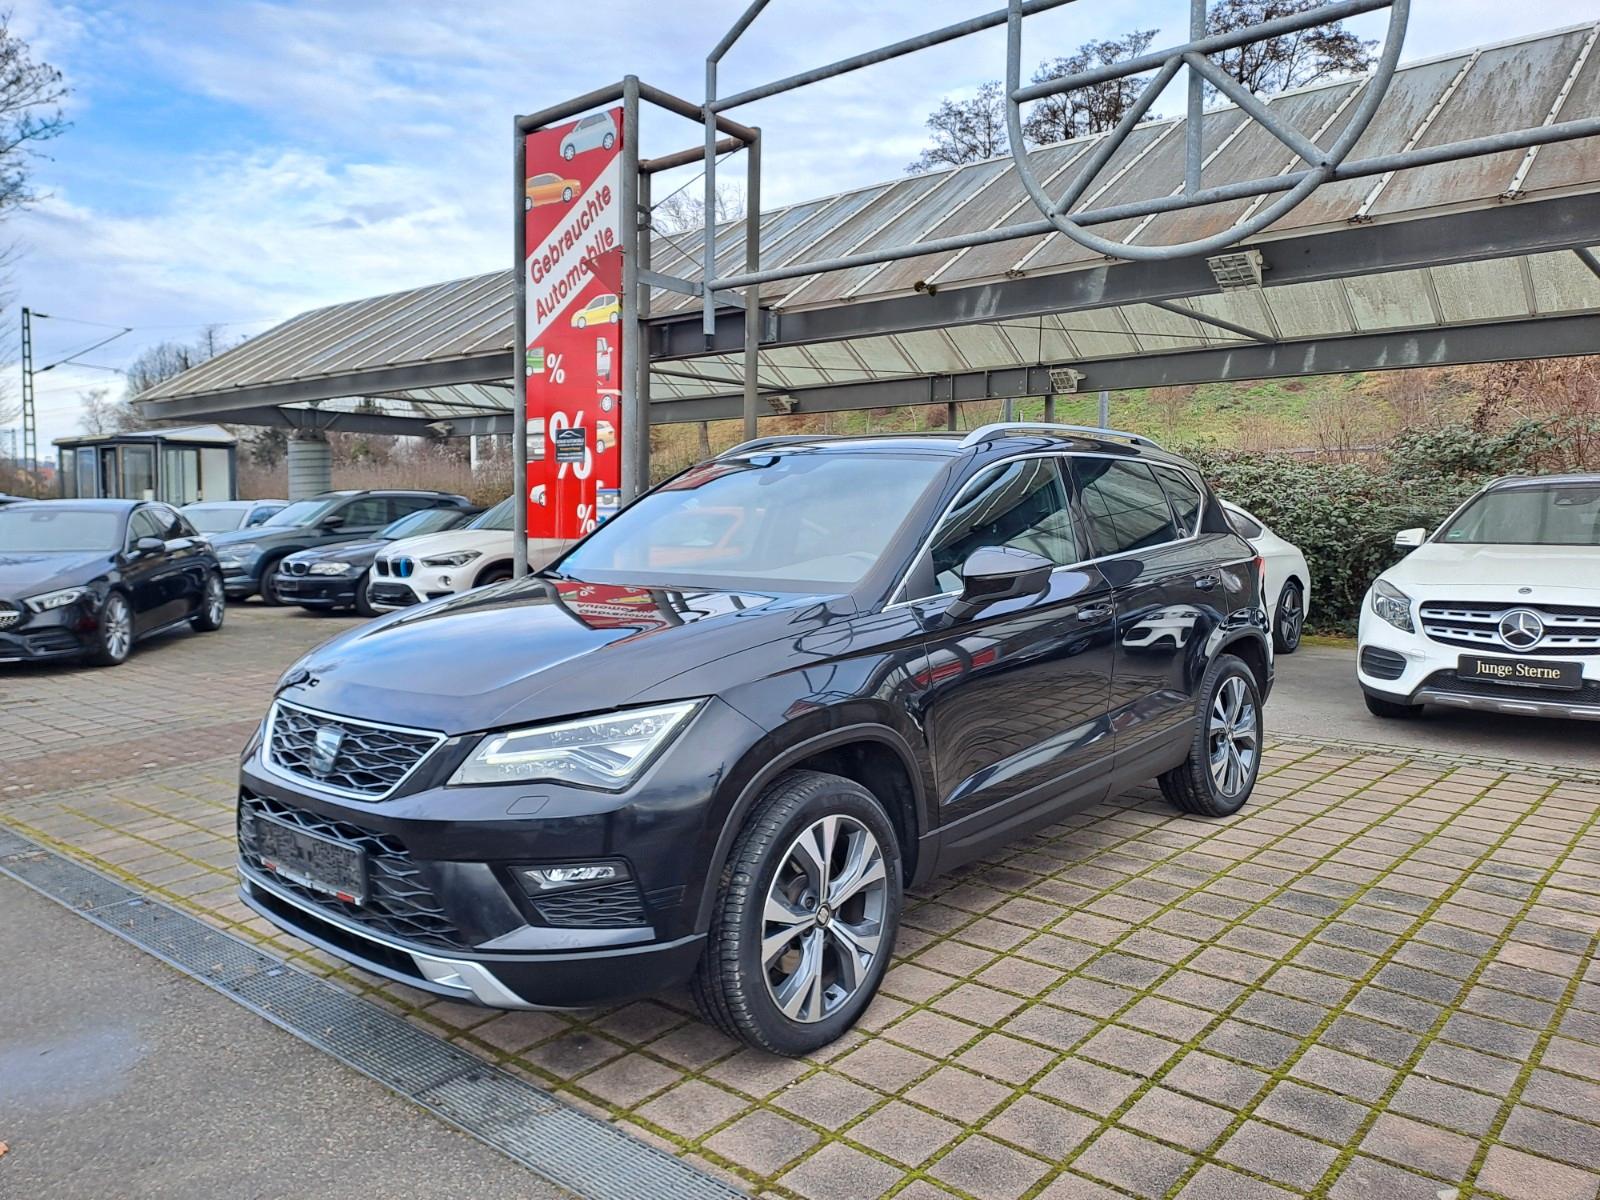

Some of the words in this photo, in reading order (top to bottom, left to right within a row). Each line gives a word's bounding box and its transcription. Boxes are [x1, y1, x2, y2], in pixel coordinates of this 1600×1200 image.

[530, 185, 612, 285] Gebrauchte
[546, 353, 565, 384] %
[1475, 660, 1513, 678] Junge
[1515, 663, 1561, 679] Sterne
